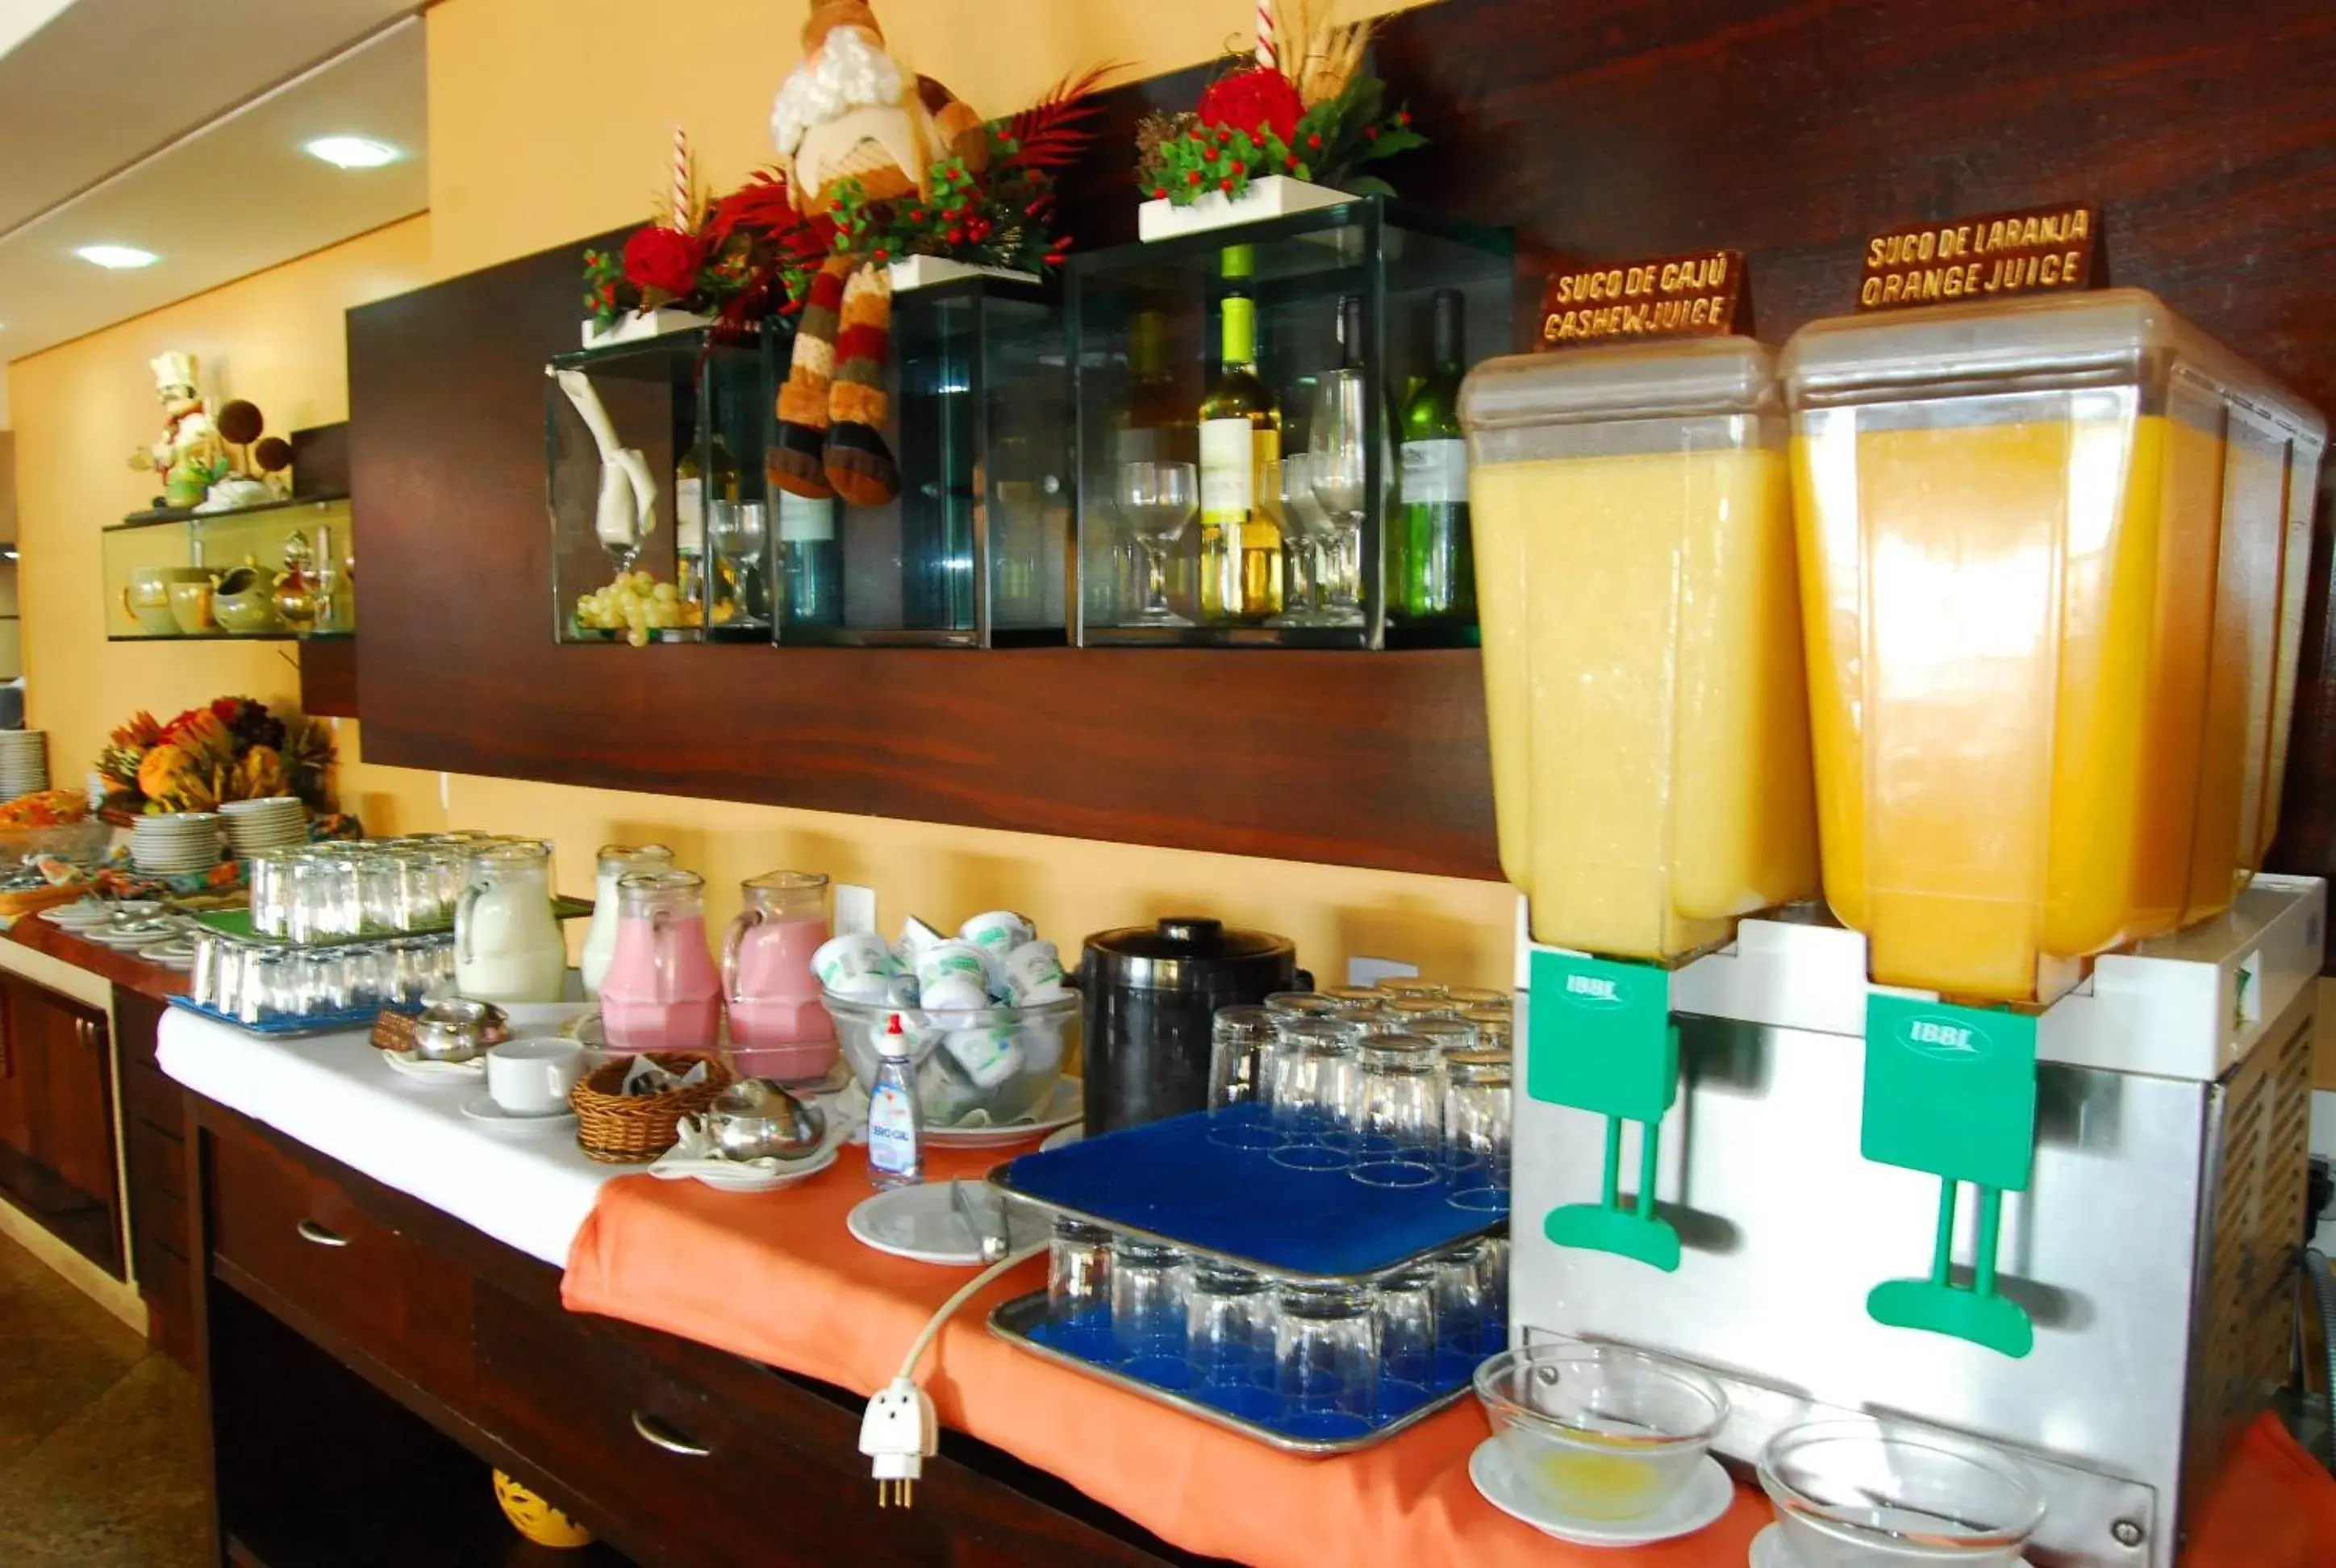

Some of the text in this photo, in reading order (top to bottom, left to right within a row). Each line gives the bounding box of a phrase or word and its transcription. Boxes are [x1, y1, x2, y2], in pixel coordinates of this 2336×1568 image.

[1867, 209, 2090, 269] SUCO DE LARANJA
[1557, 269, 1624, 305] SUCO
[1625, 265, 1658, 296] DE
[1861, 251, 2082, 307] ORANGE JUICE
[1544, 296, 1725, 340] CASHEW JUICE
[1566, 974, 1618, 1001] IBBL
[1910, 1021, 1976, 1051] IBBL
